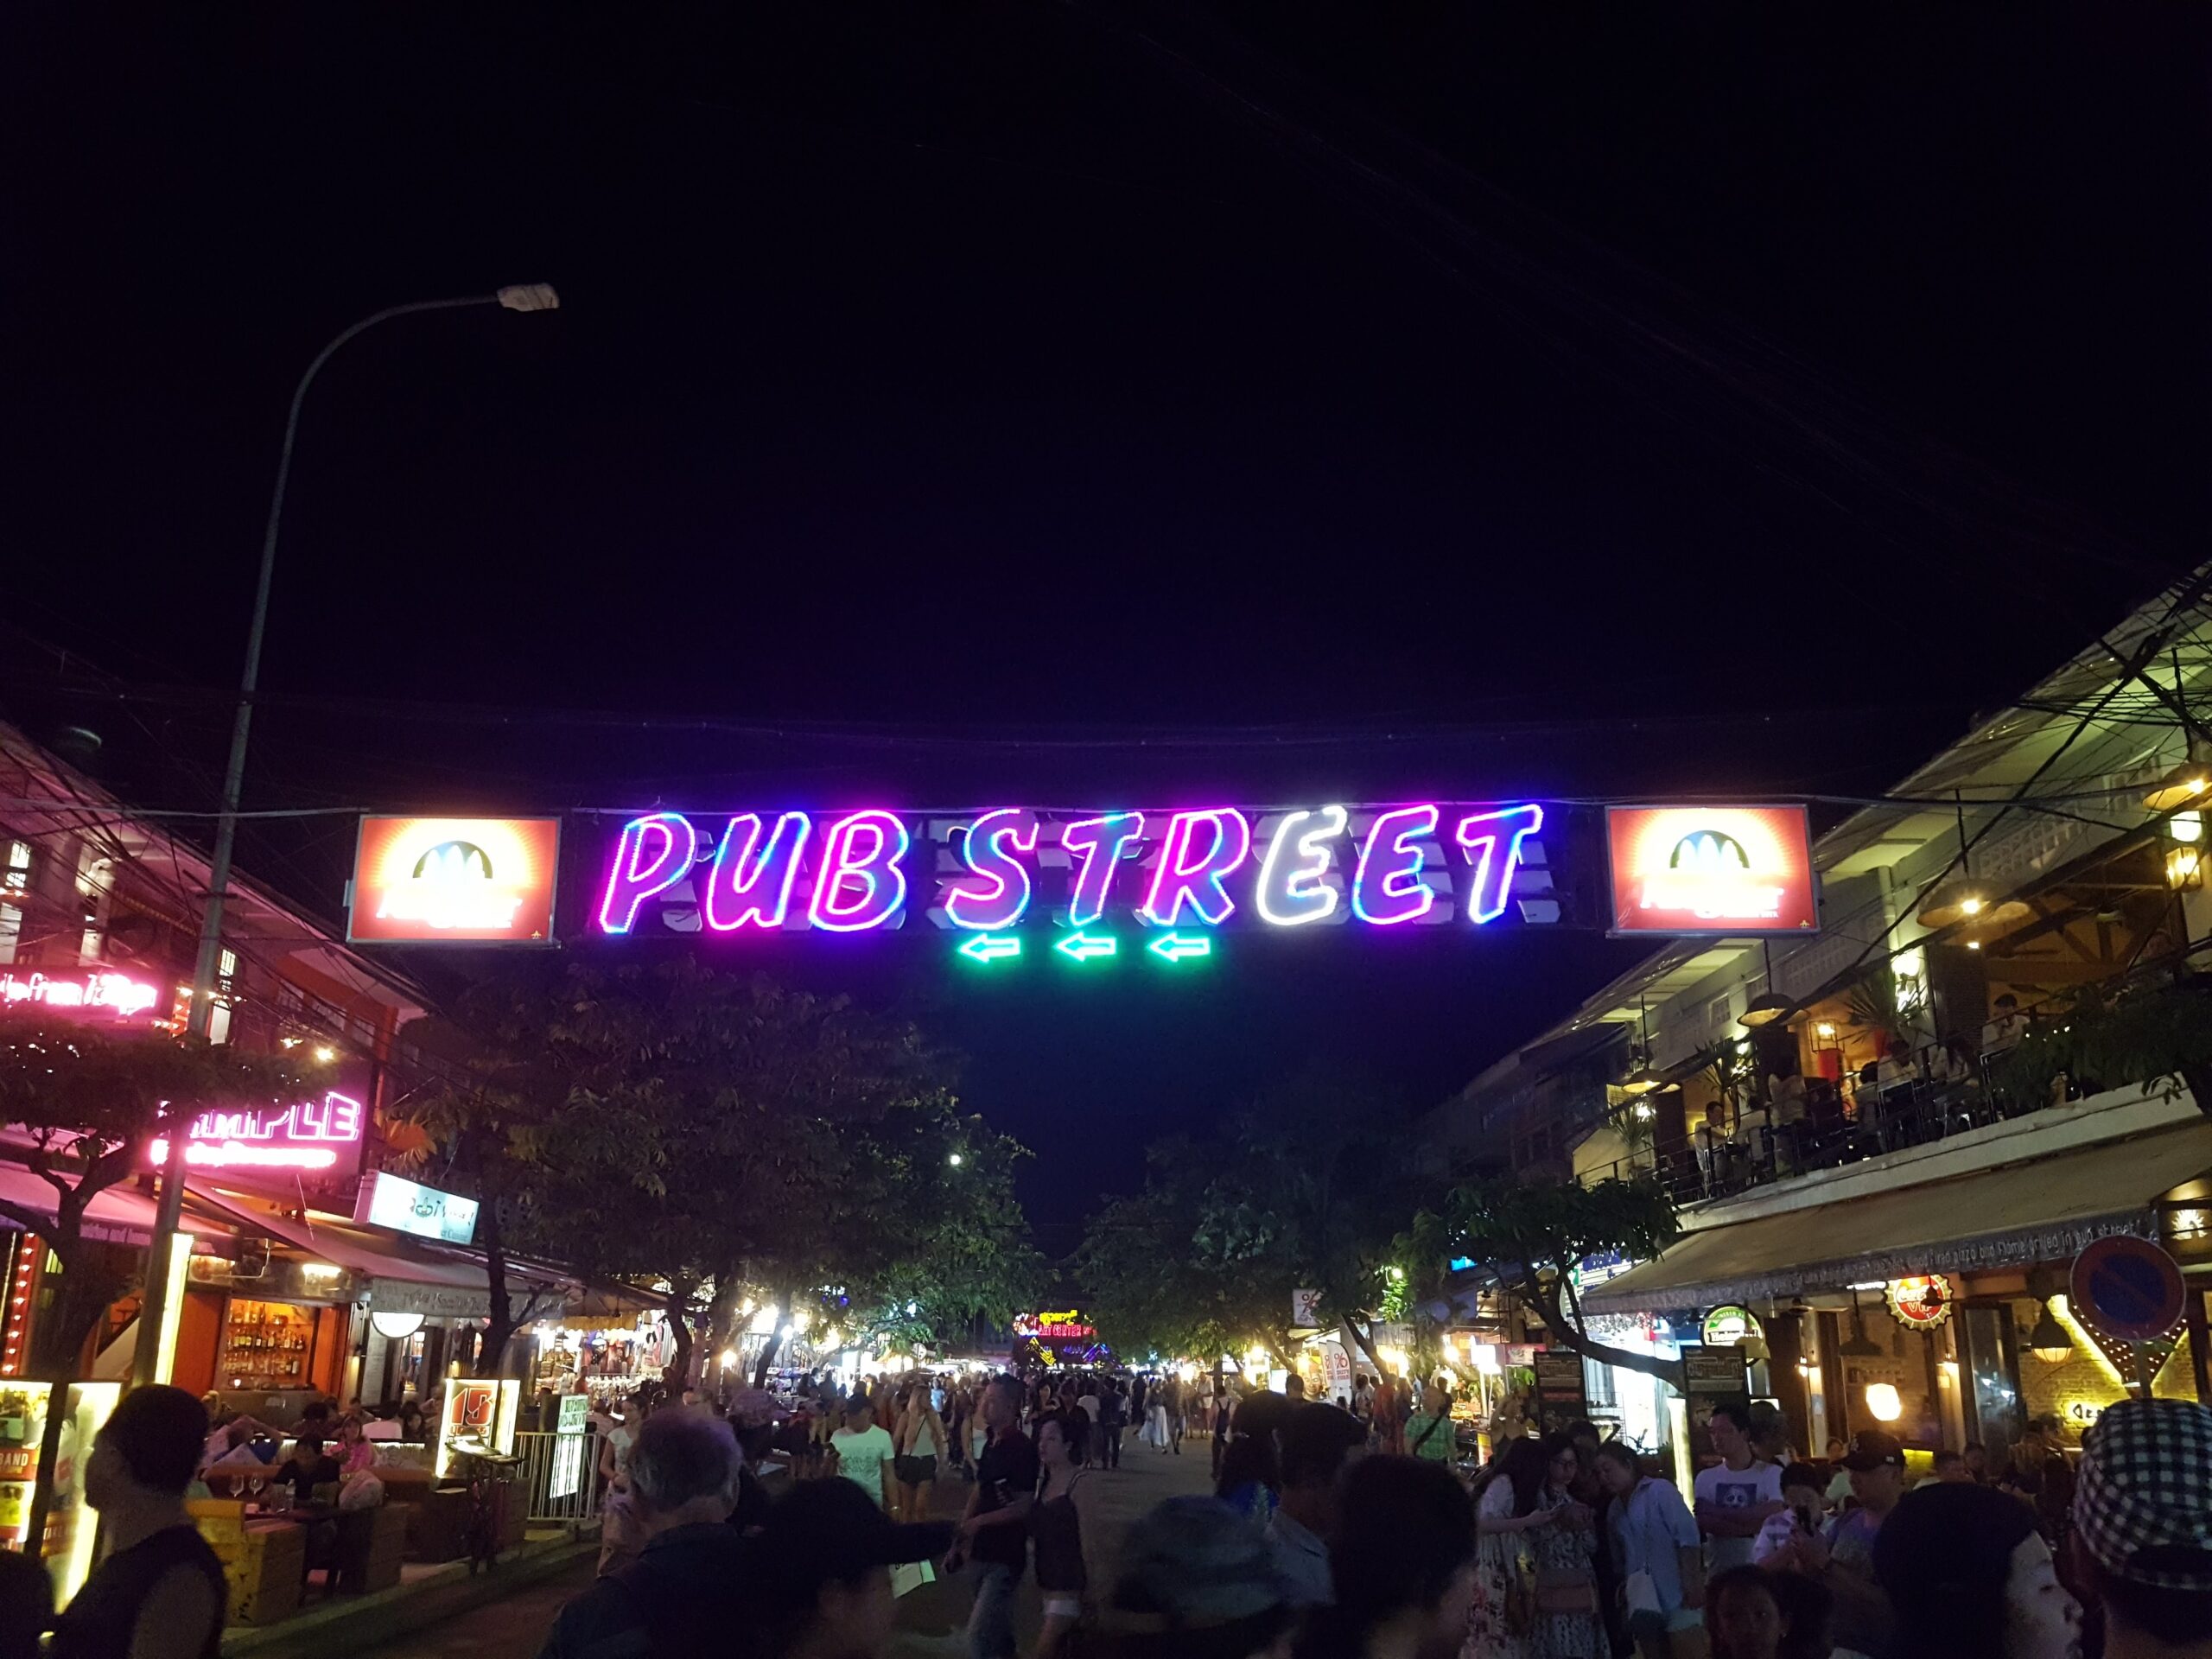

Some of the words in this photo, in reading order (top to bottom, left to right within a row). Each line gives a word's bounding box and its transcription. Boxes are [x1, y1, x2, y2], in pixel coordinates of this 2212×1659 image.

[600, 809, 910, 935] PUB
[945, 804, 1545, 931] STREET
[1052, 1324, 1082, 1337] CENTER
